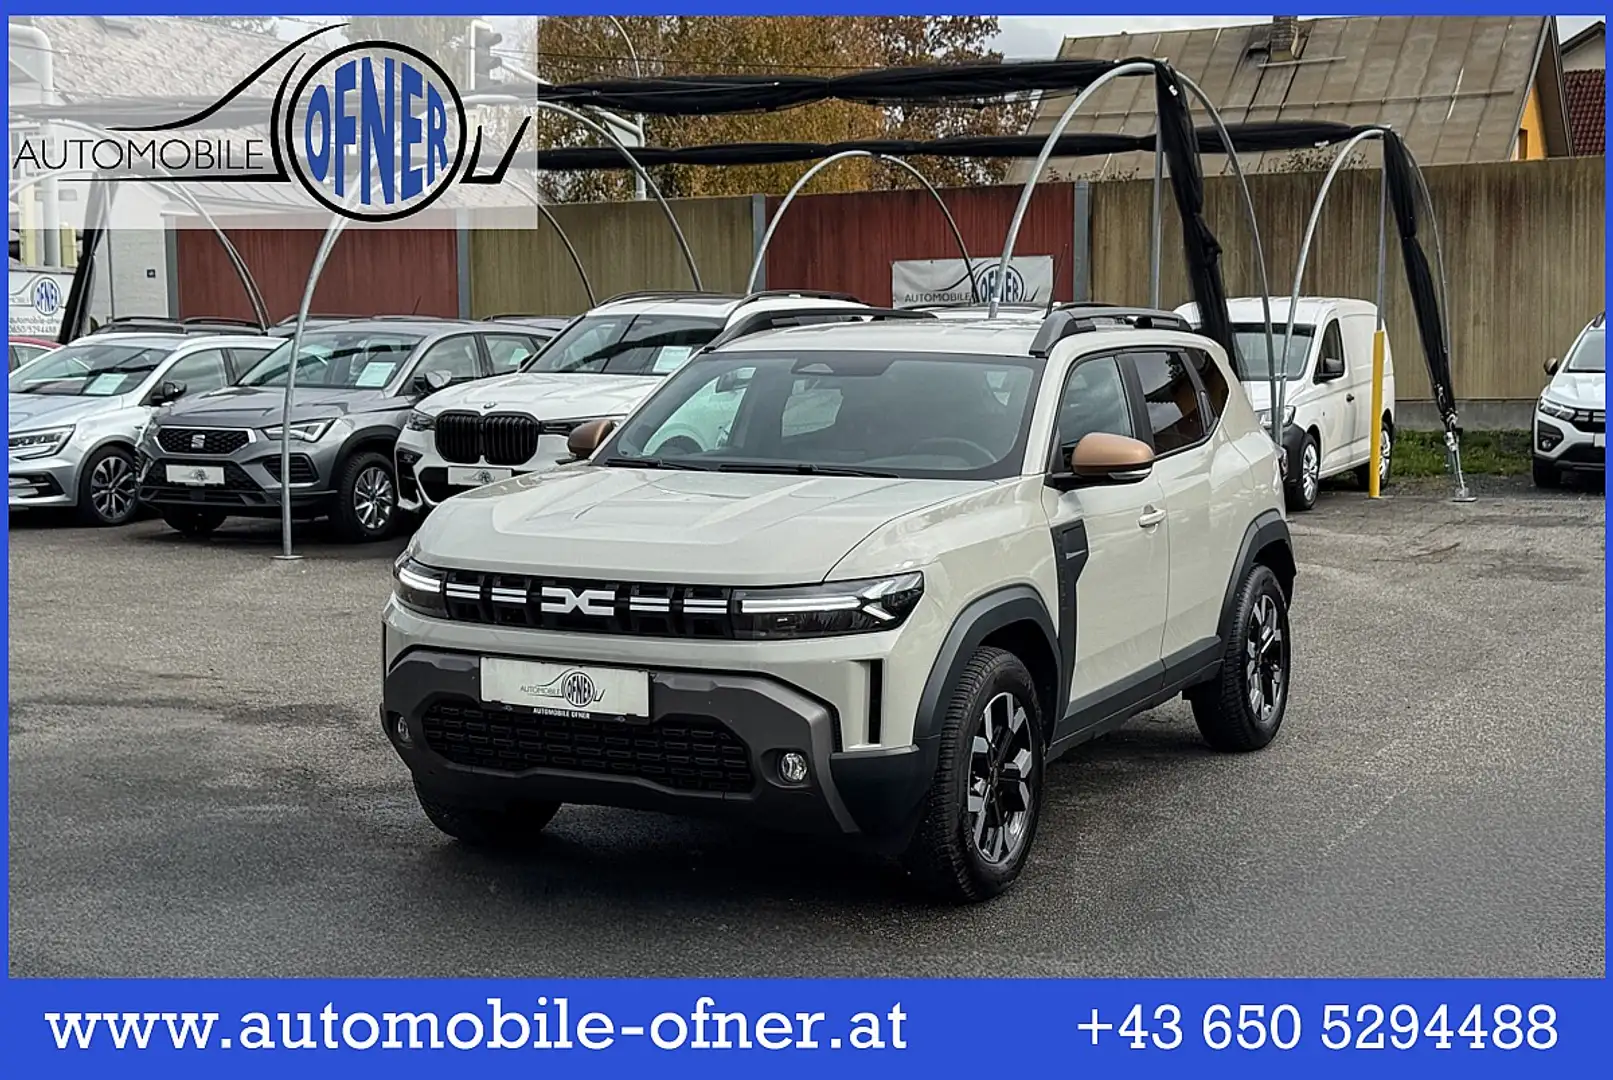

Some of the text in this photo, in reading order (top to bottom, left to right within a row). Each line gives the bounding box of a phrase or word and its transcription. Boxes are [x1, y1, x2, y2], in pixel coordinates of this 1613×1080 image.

[904, 292, 971, 303] AUTOMOBILE
[521, 675, 591, 704] AUTOMOBILE OFNER
[533, 708, 570, 718] AUTOMOBILE
